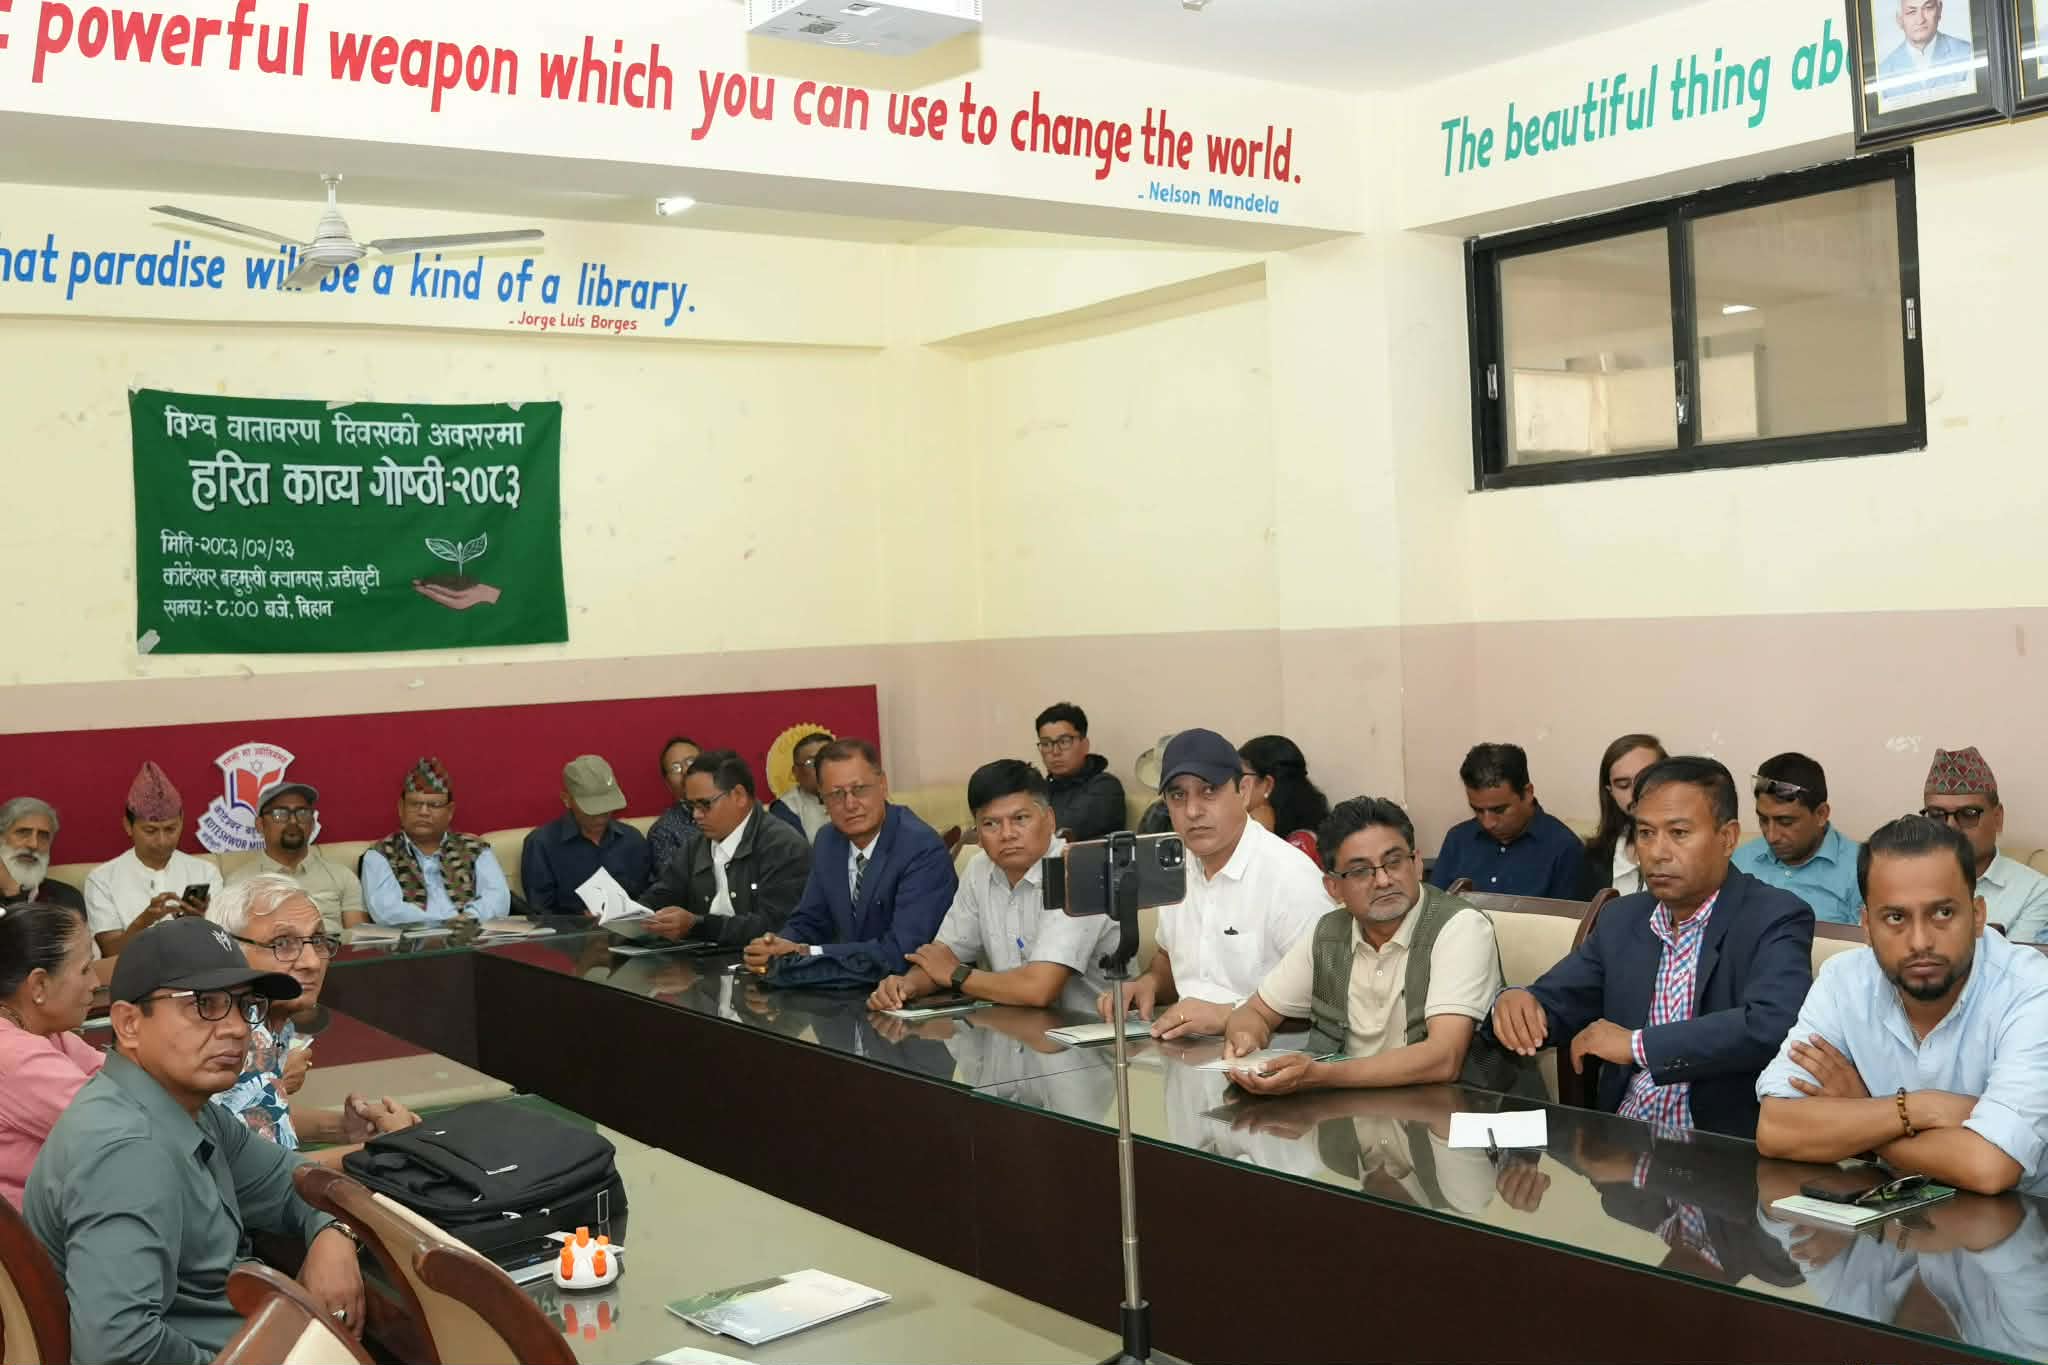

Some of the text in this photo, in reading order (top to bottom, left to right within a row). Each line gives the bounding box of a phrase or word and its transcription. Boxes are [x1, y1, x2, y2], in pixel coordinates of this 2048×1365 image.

[33, 0, 309, 83] powerful
[330, 32, 518, 112] weapon
[541, 36, 672, 110] which
[692, 71, 774, 140] you
[795, 81, 869, 130] can
[888, 93, 947, 140] use
[960, 82, 997, 144] to
[1011, 91, 1132, 180] change
[1142, 109, 1193, 170] the
[1208, 127, 1301, 184] world.
[1441, 18, 1850, 177] The beautiful thing ab
[1149, 181, 1201, 206] Nelson
[1207, 187, 1280, 214] Mandela
[67, 240, 225, 300] paradise
[373, 265, 393, 295] a
[411, 254, 483, 301] kind
[498, 260, 534, 304] of
[542, 274, 560, 305] a
[577, 264, 695, 327] library.
[518, 311, 556, 331] Jorge
[560, 312, 585, 327] Luis
[591, 314, 638, 335] Borges
[164, 404, 525, 450] विश्व वातावरण दिवसको अवसरमा
[188, 449, 271, 511] हरित
[283, 463, 363, 506] काव्य
[162, 561, 219, 590] कोटेश्वर
[220, 565, 266, 597] बहुमुखी
[296, 595, 334, 620] बिहान
[203, 816, 247, 849] KOTESHWOR
